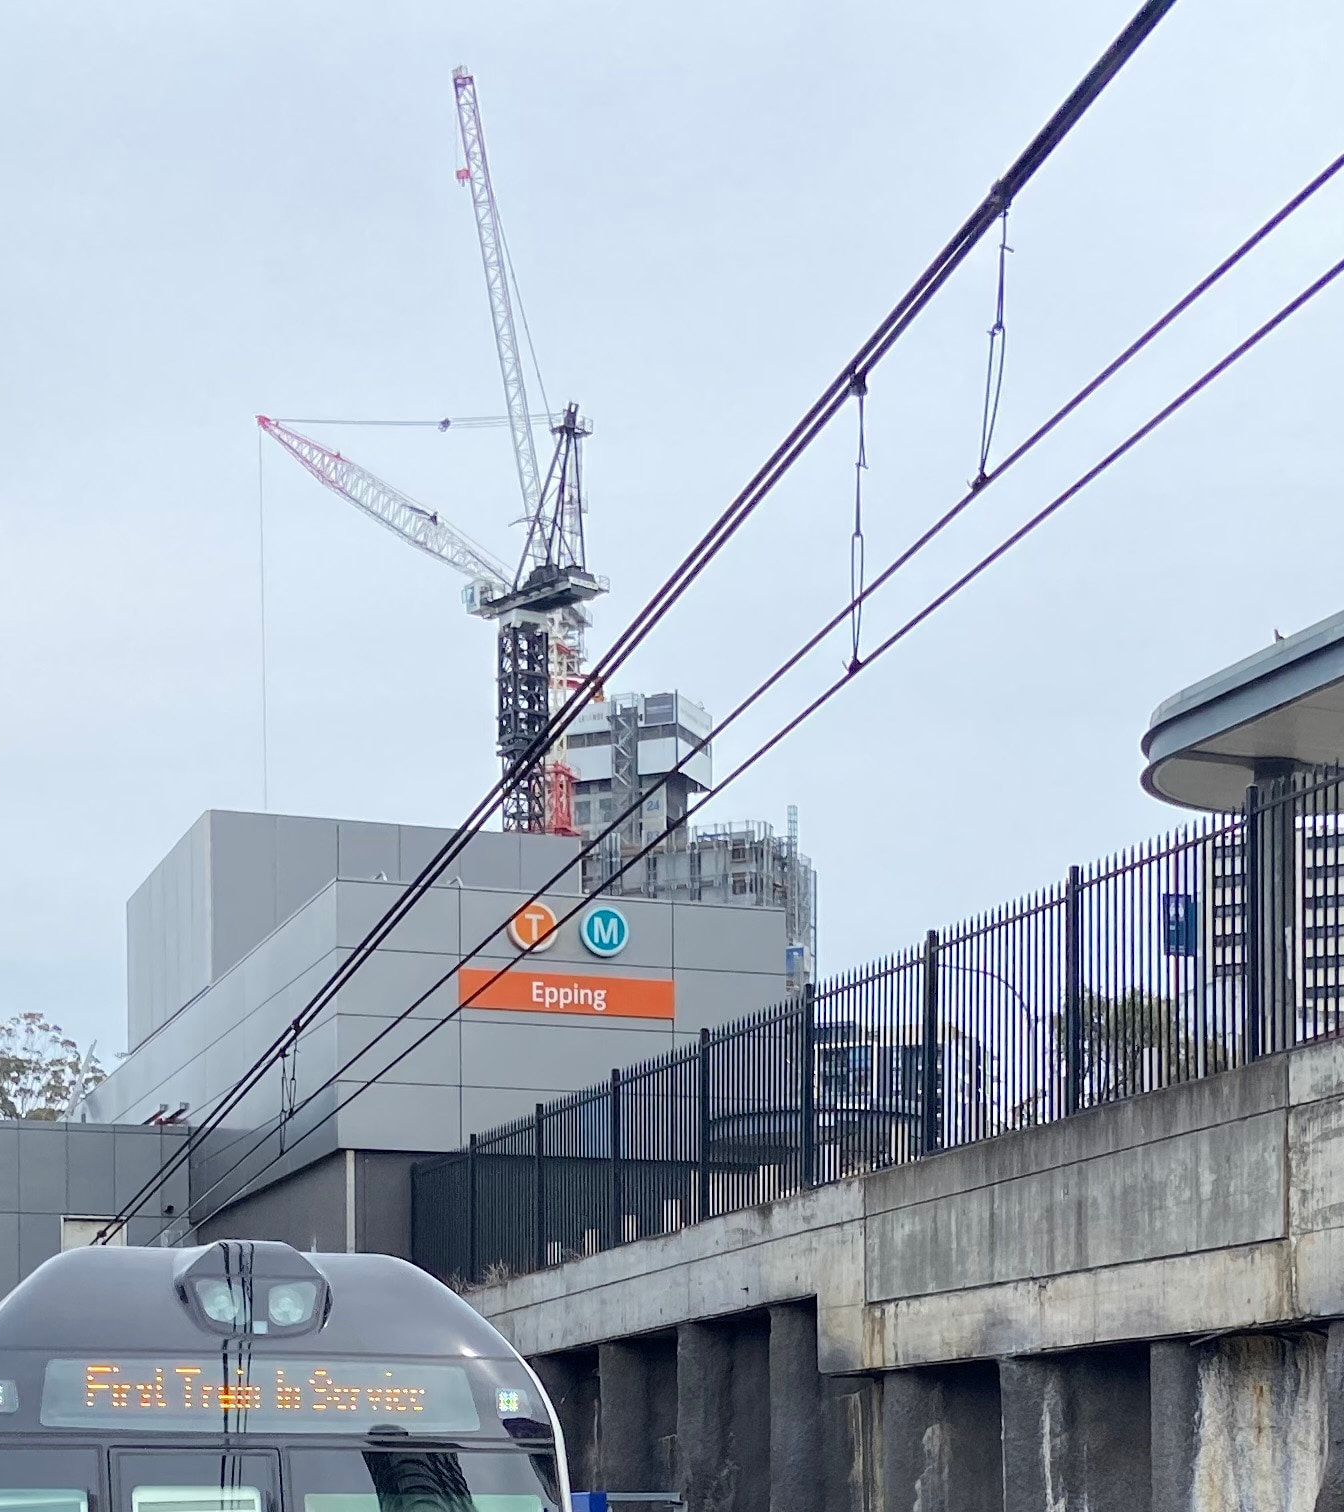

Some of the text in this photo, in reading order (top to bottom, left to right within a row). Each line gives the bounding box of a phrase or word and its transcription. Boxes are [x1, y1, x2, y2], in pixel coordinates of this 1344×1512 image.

[524, 913, 619, 945] T M
[532, 981, 607, 1011] Epping
